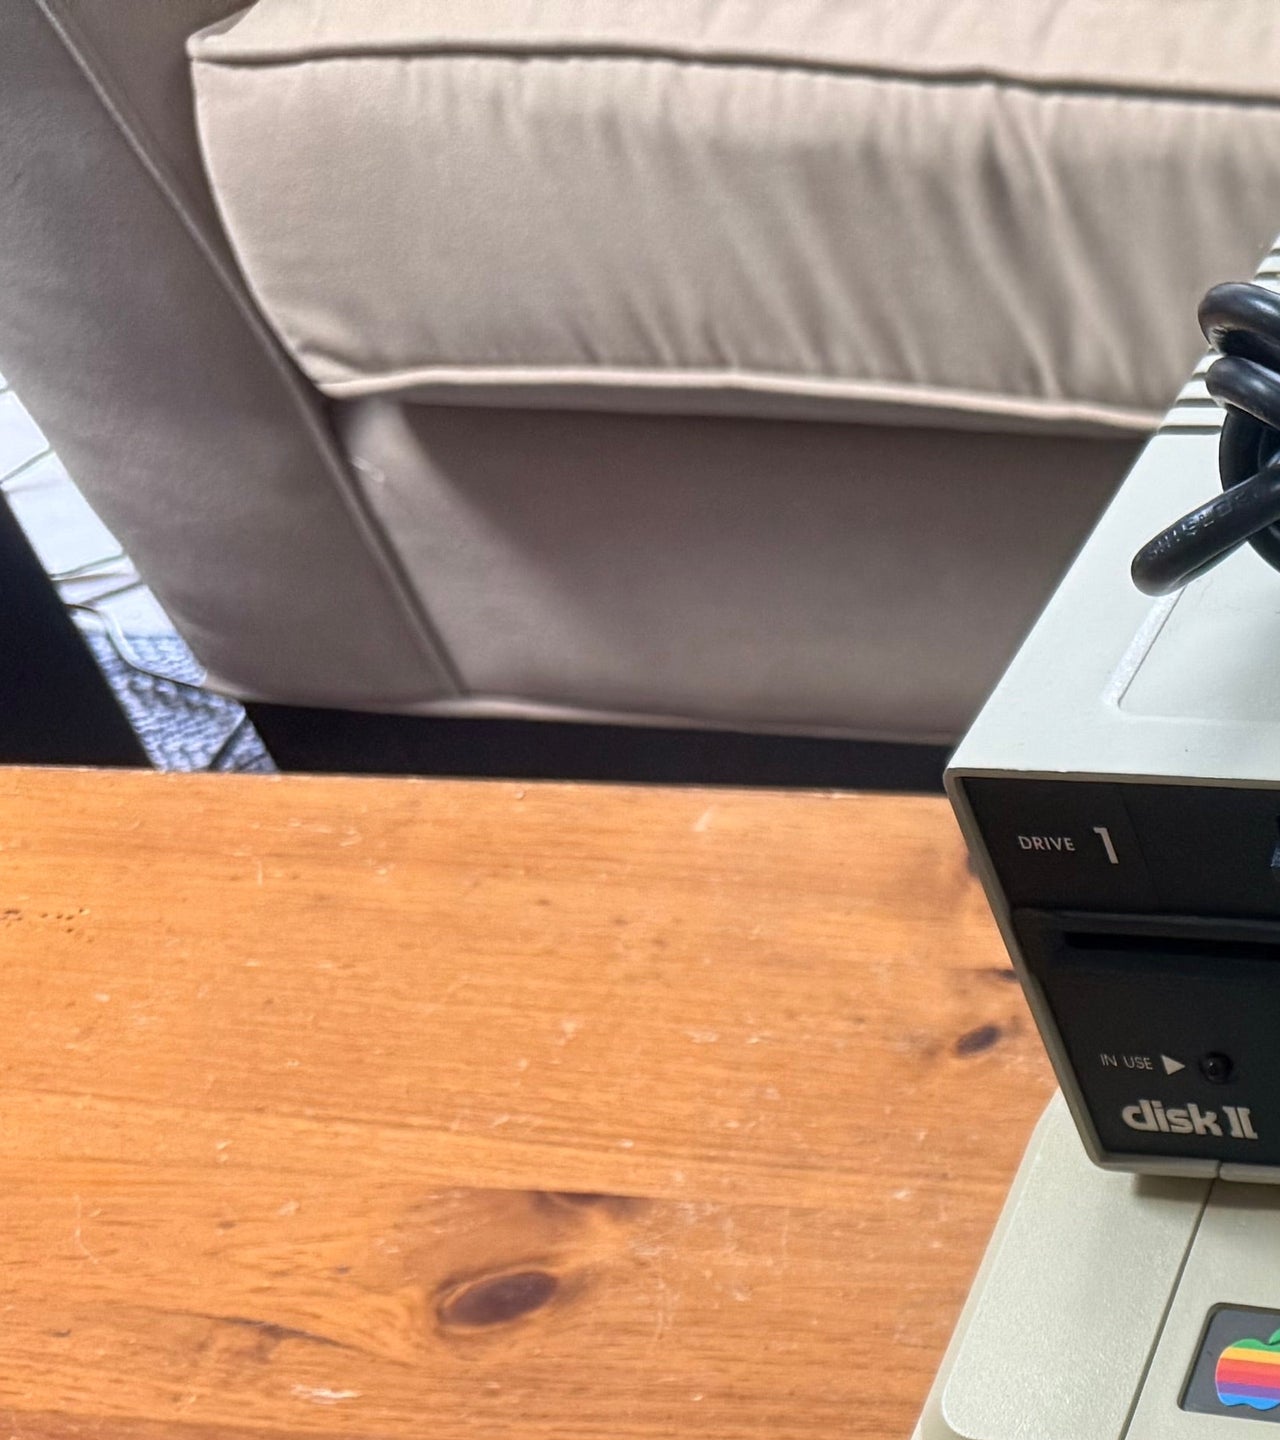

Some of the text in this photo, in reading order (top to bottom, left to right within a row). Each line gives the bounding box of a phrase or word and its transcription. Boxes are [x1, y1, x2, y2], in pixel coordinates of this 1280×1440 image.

[1018, 826, 1119, 864] DRIVE 1
[1100, 1053, 1153, 1071] IN USE
[1121, 1099, 1224, 1137] disk
